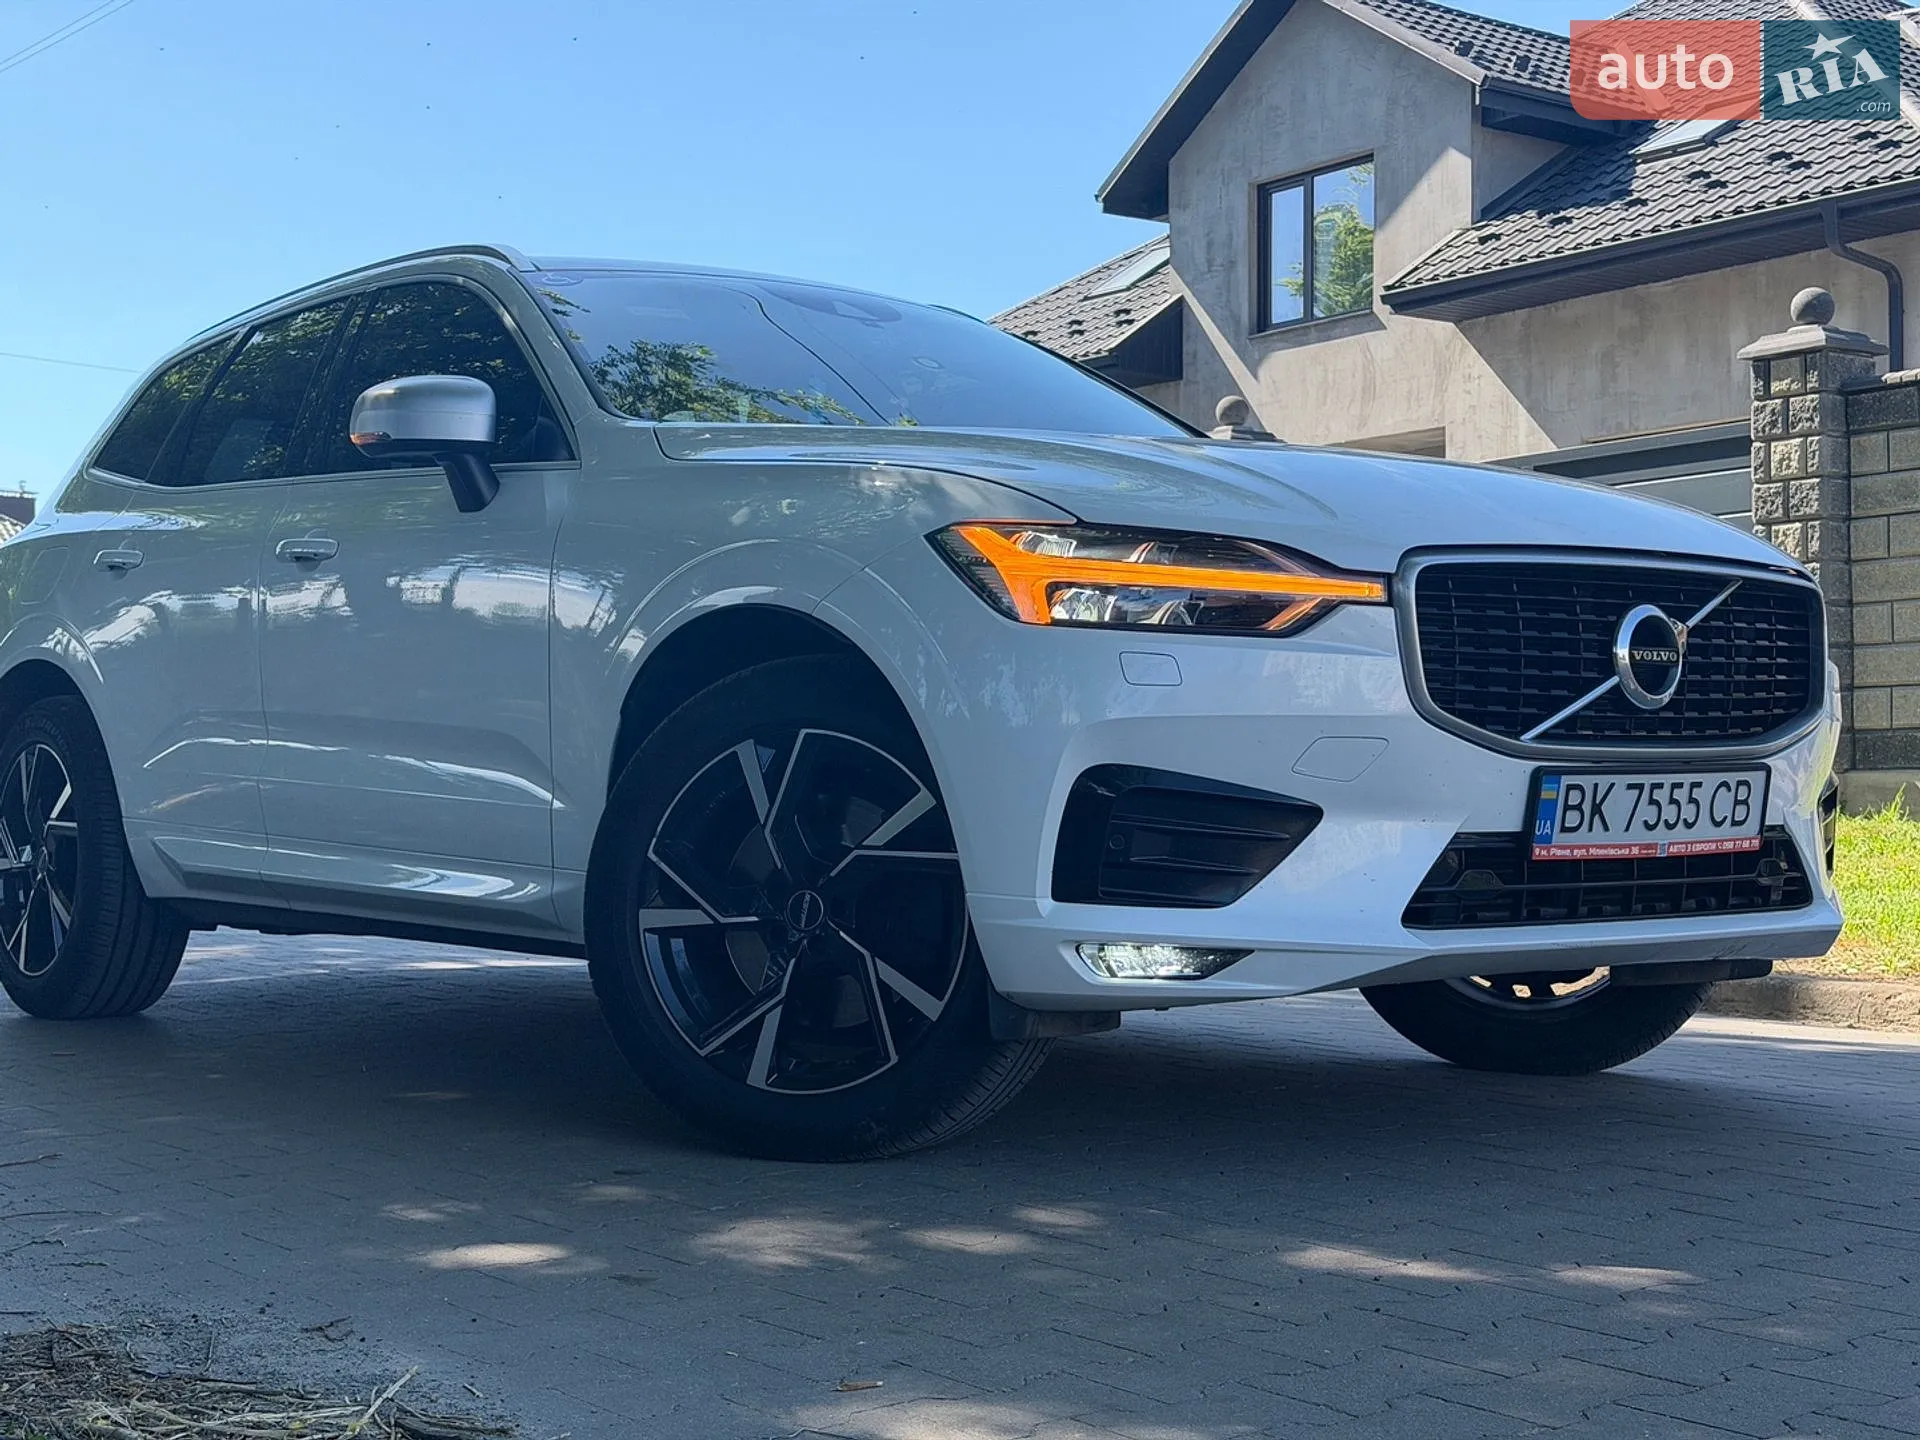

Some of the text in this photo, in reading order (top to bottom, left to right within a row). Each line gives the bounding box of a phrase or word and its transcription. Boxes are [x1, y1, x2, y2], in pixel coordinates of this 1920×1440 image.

[1632, 650, 1678, 661] VOLVO
[1559, 779, 1752, 833] BK 7555 CB
[1534, 819, 1551, 836] UA
